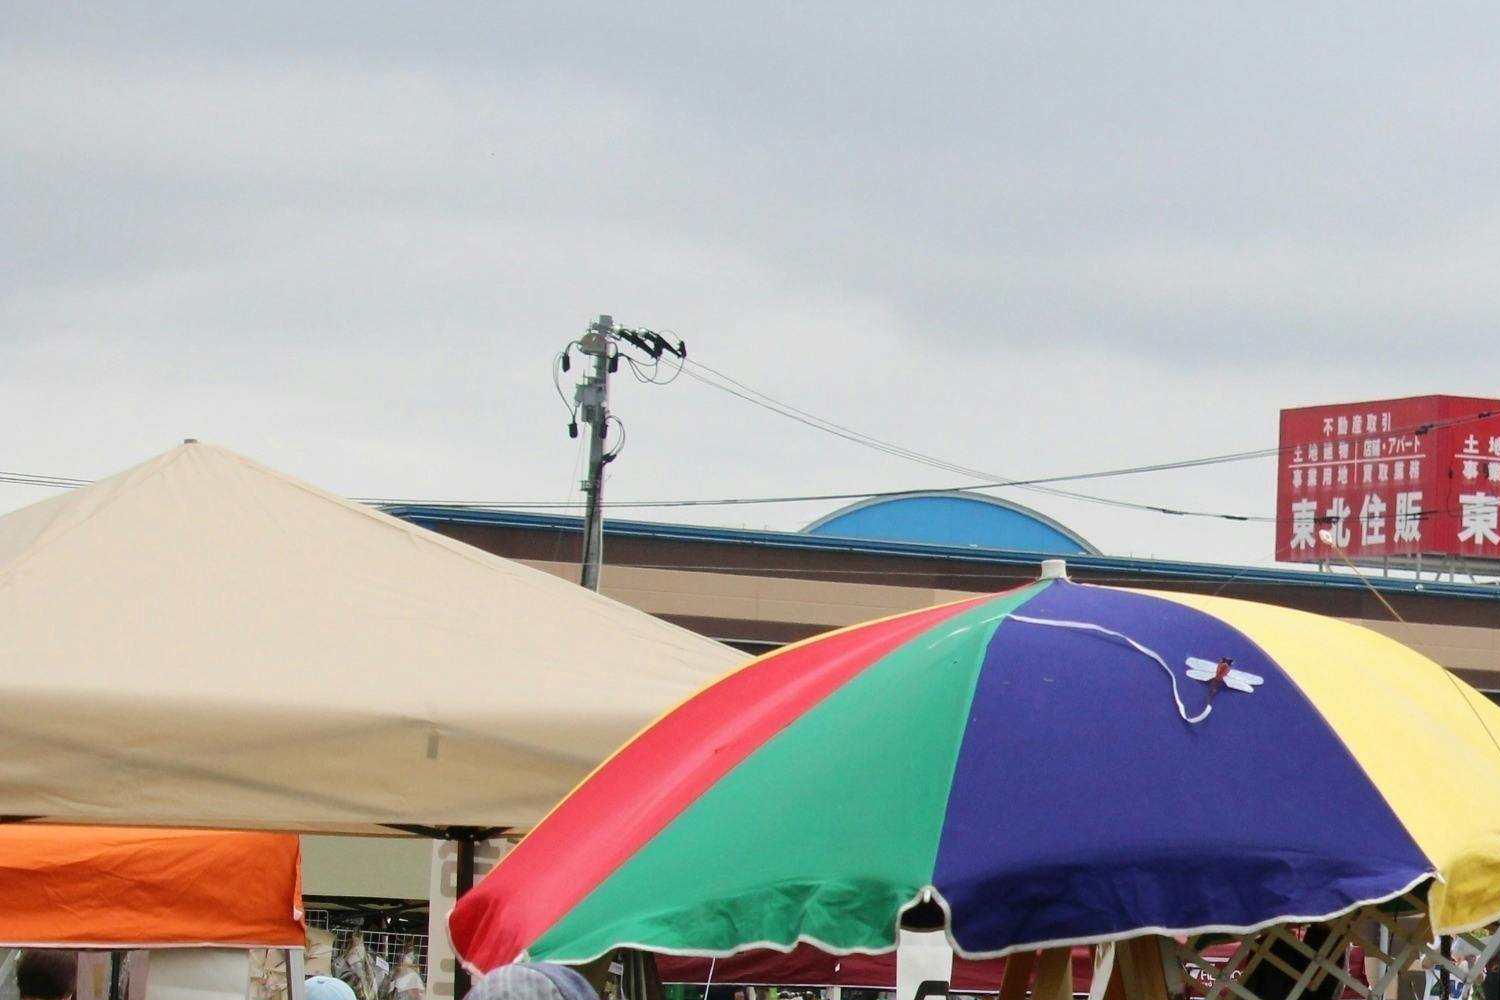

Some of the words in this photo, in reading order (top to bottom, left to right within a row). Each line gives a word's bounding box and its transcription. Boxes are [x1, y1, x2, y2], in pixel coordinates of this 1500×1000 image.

[1323, 412, 1391, 437] 不動産取引
[1293, 439, 1349, 463] 土地建物
